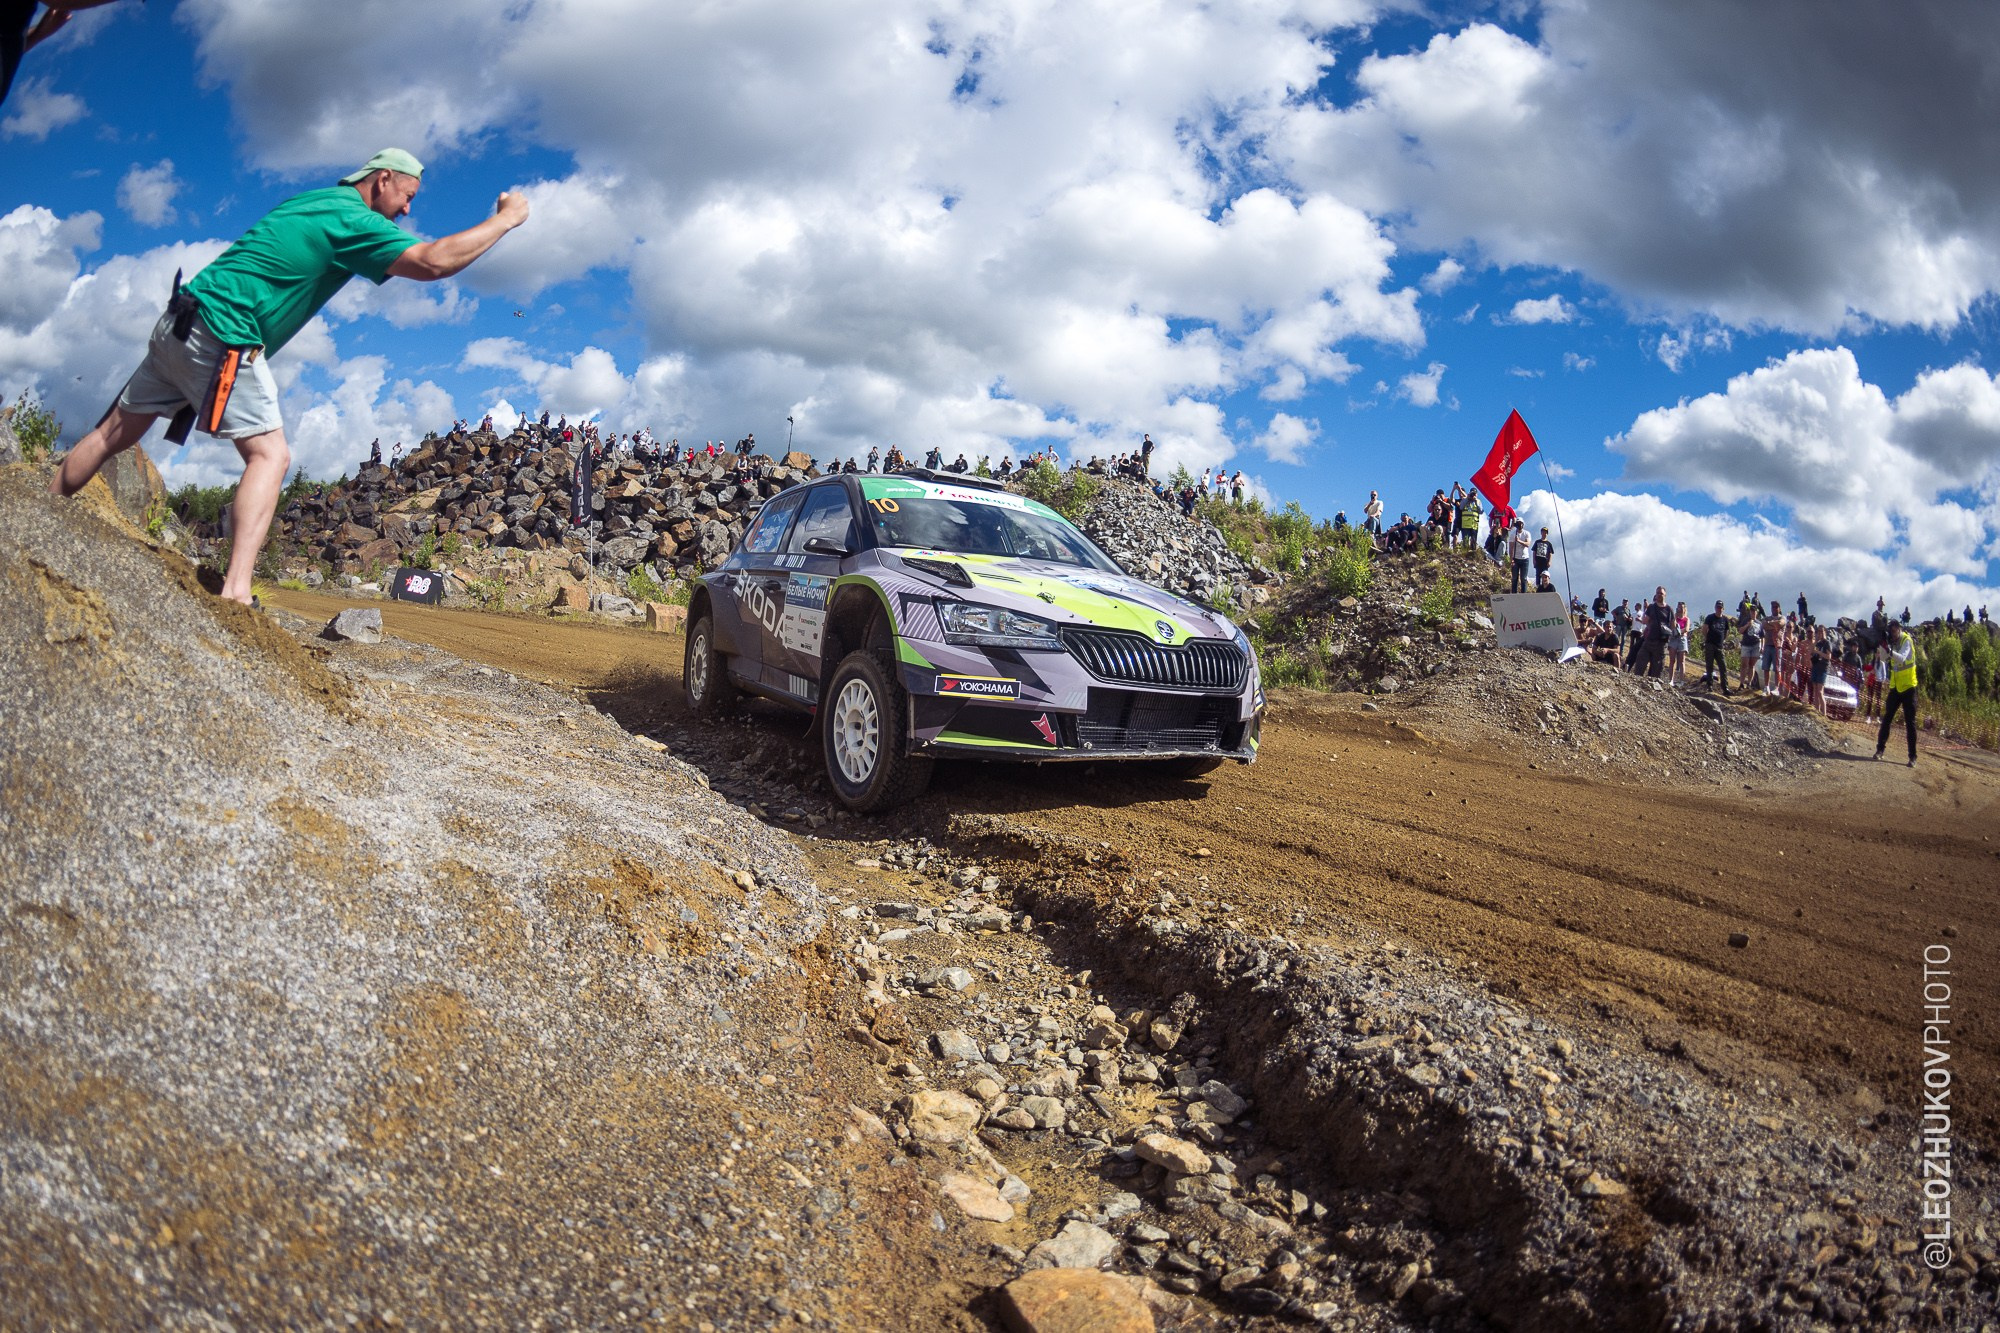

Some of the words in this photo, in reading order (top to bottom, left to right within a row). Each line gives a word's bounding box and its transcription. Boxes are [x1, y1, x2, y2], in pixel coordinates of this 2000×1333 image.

[868, 498, 900, 514] 10
[1509, 616, 1565, 632] ТАТНЕФТЬ
[959, 681, 1014, 694] YOKOHAMA
